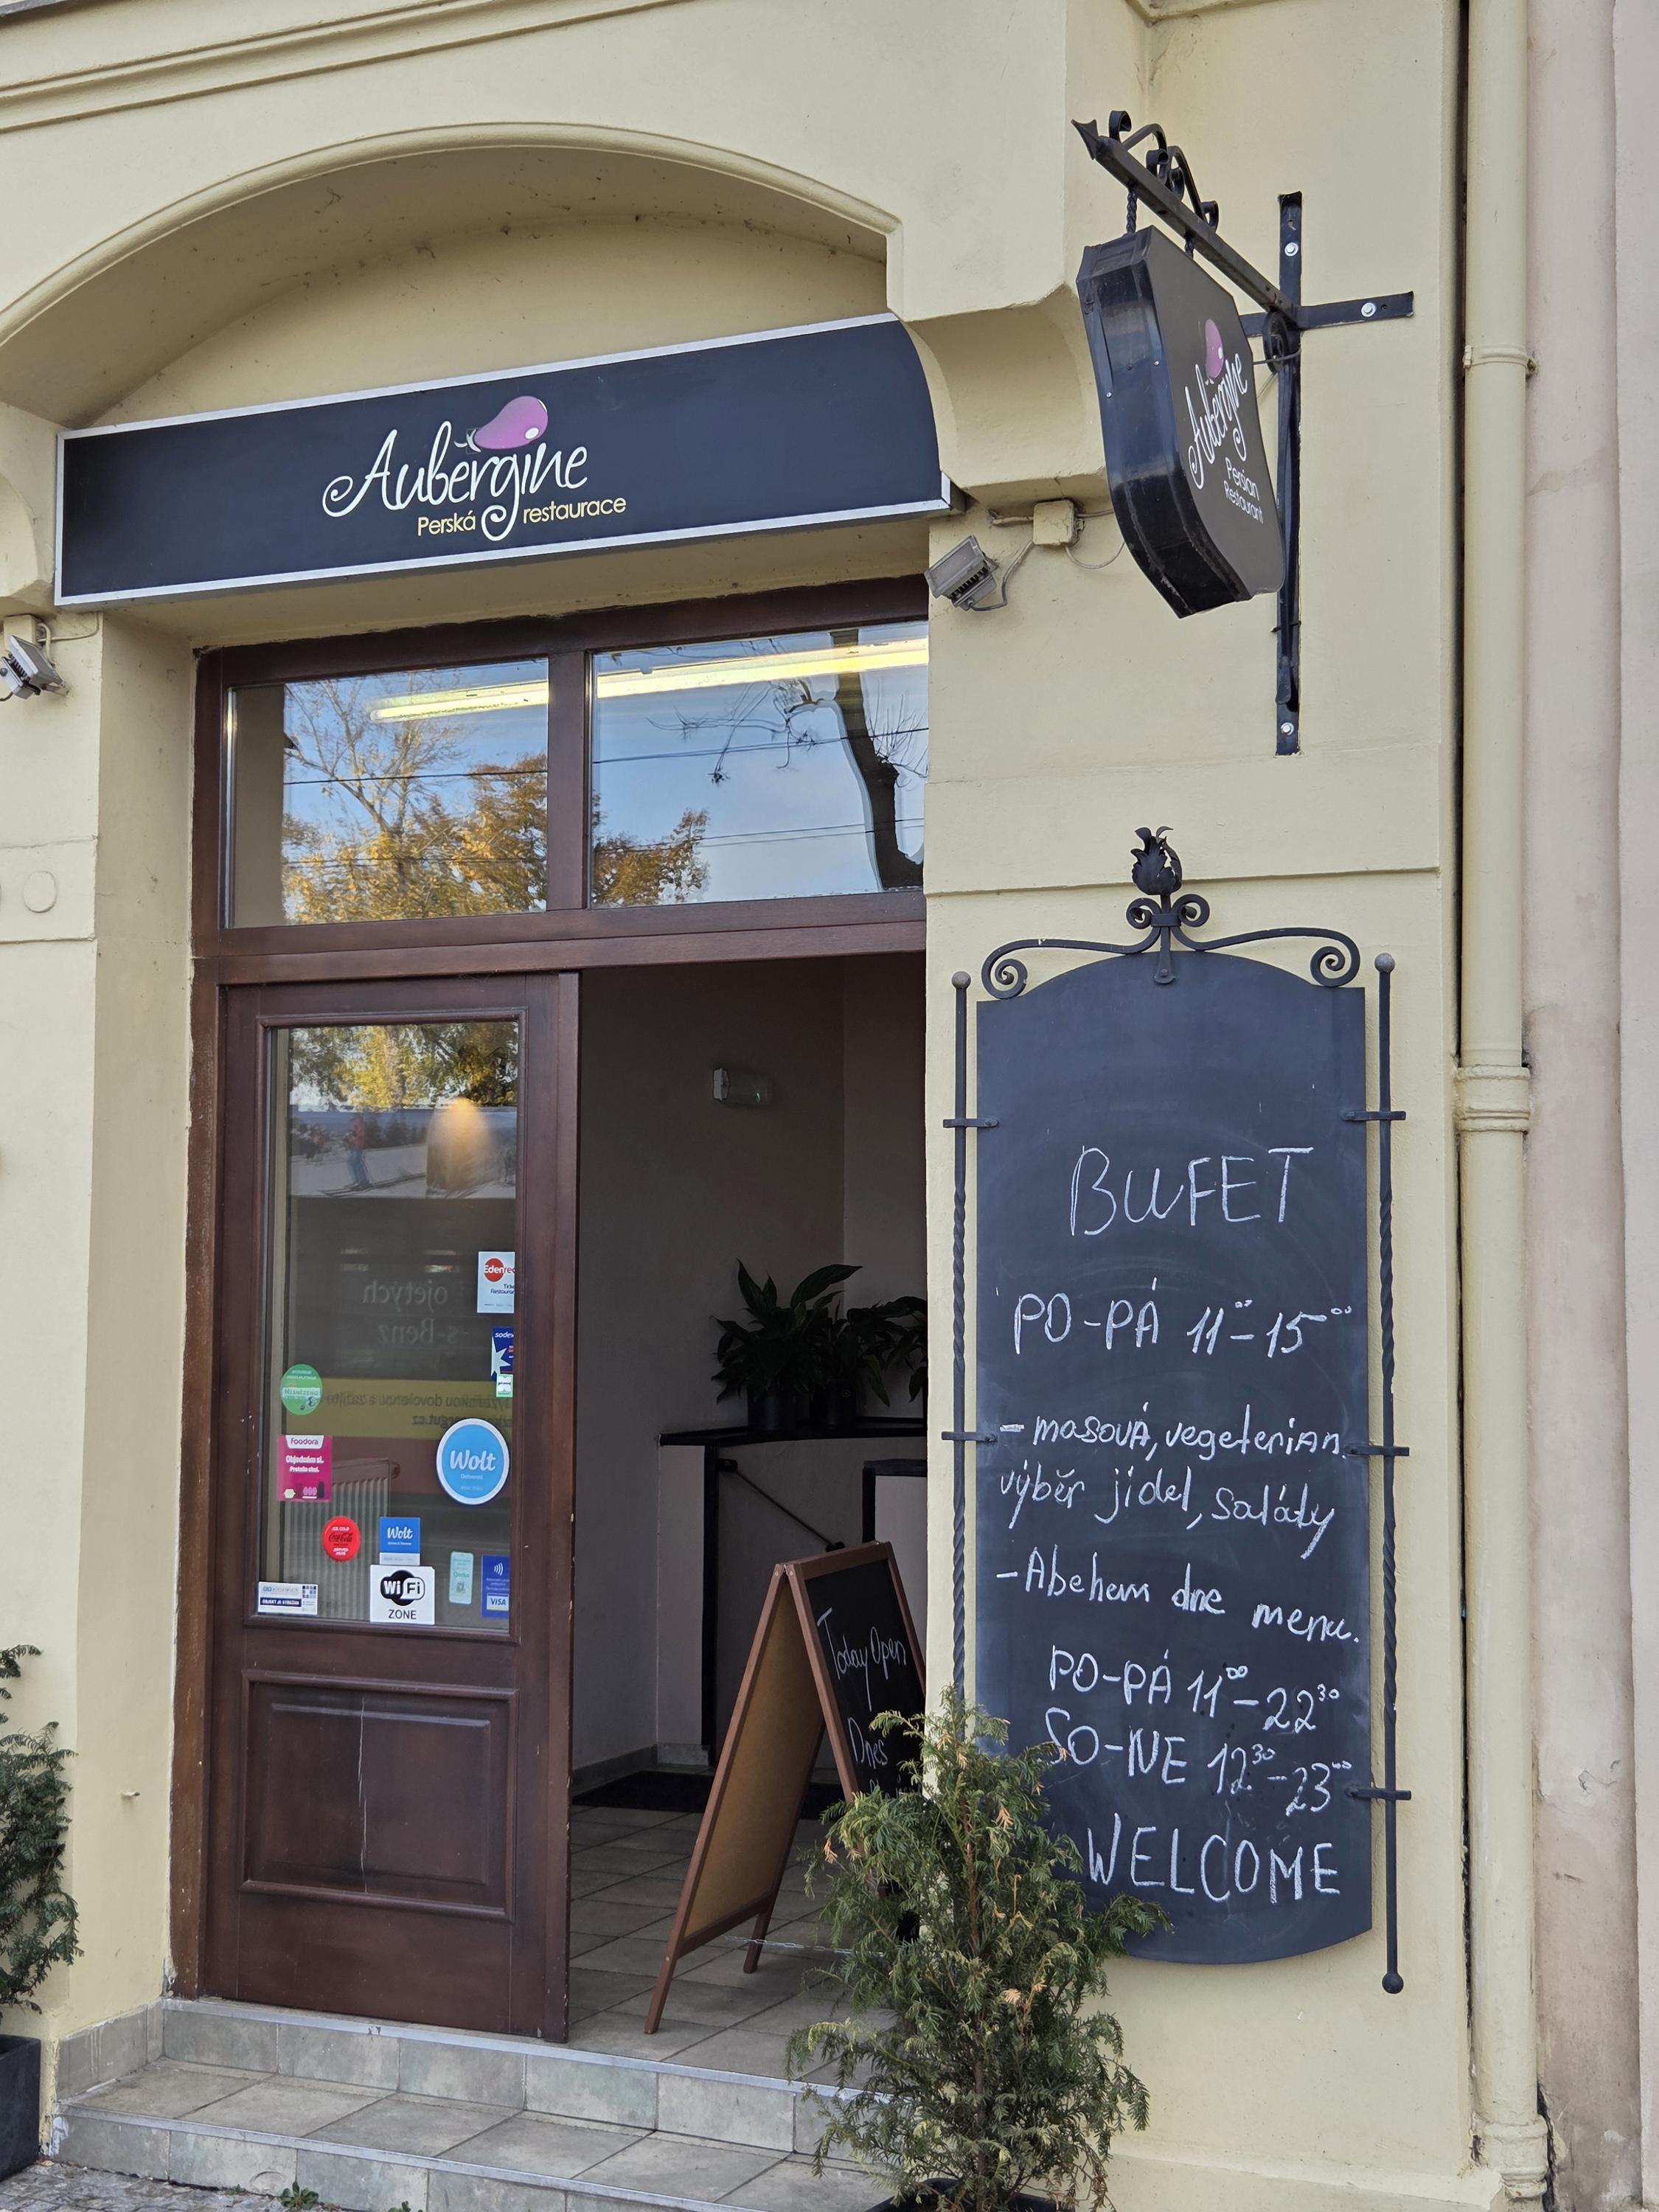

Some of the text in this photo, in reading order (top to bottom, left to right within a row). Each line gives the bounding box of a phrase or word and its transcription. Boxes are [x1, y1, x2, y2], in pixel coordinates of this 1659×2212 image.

[1185, 353, 1248, 490] Aubergine
[321, 421, 588, 542] Aubergine
[1225, 456, 1260, 501] Persian
[417, 497, 627, 537] Perská restaurace
[1223, 480, 1264, 525] Restaurant
[1071, 1146, 1314, 1237] BUFET
[291, 1437, 319, 1445] foodora
[450, 1449, 496, 1472] Wolt
[387, 1526, 413, 1540] Wolt
[389, 1609, 417, 1620] ZONE
[490, 1598, 507, 1606] VISA
[816, 1607, 907, 1712] Today Open
[847, 1717, 888, 1770] Dnes
[1087, 1812, 1340, 1904] WELCOME
